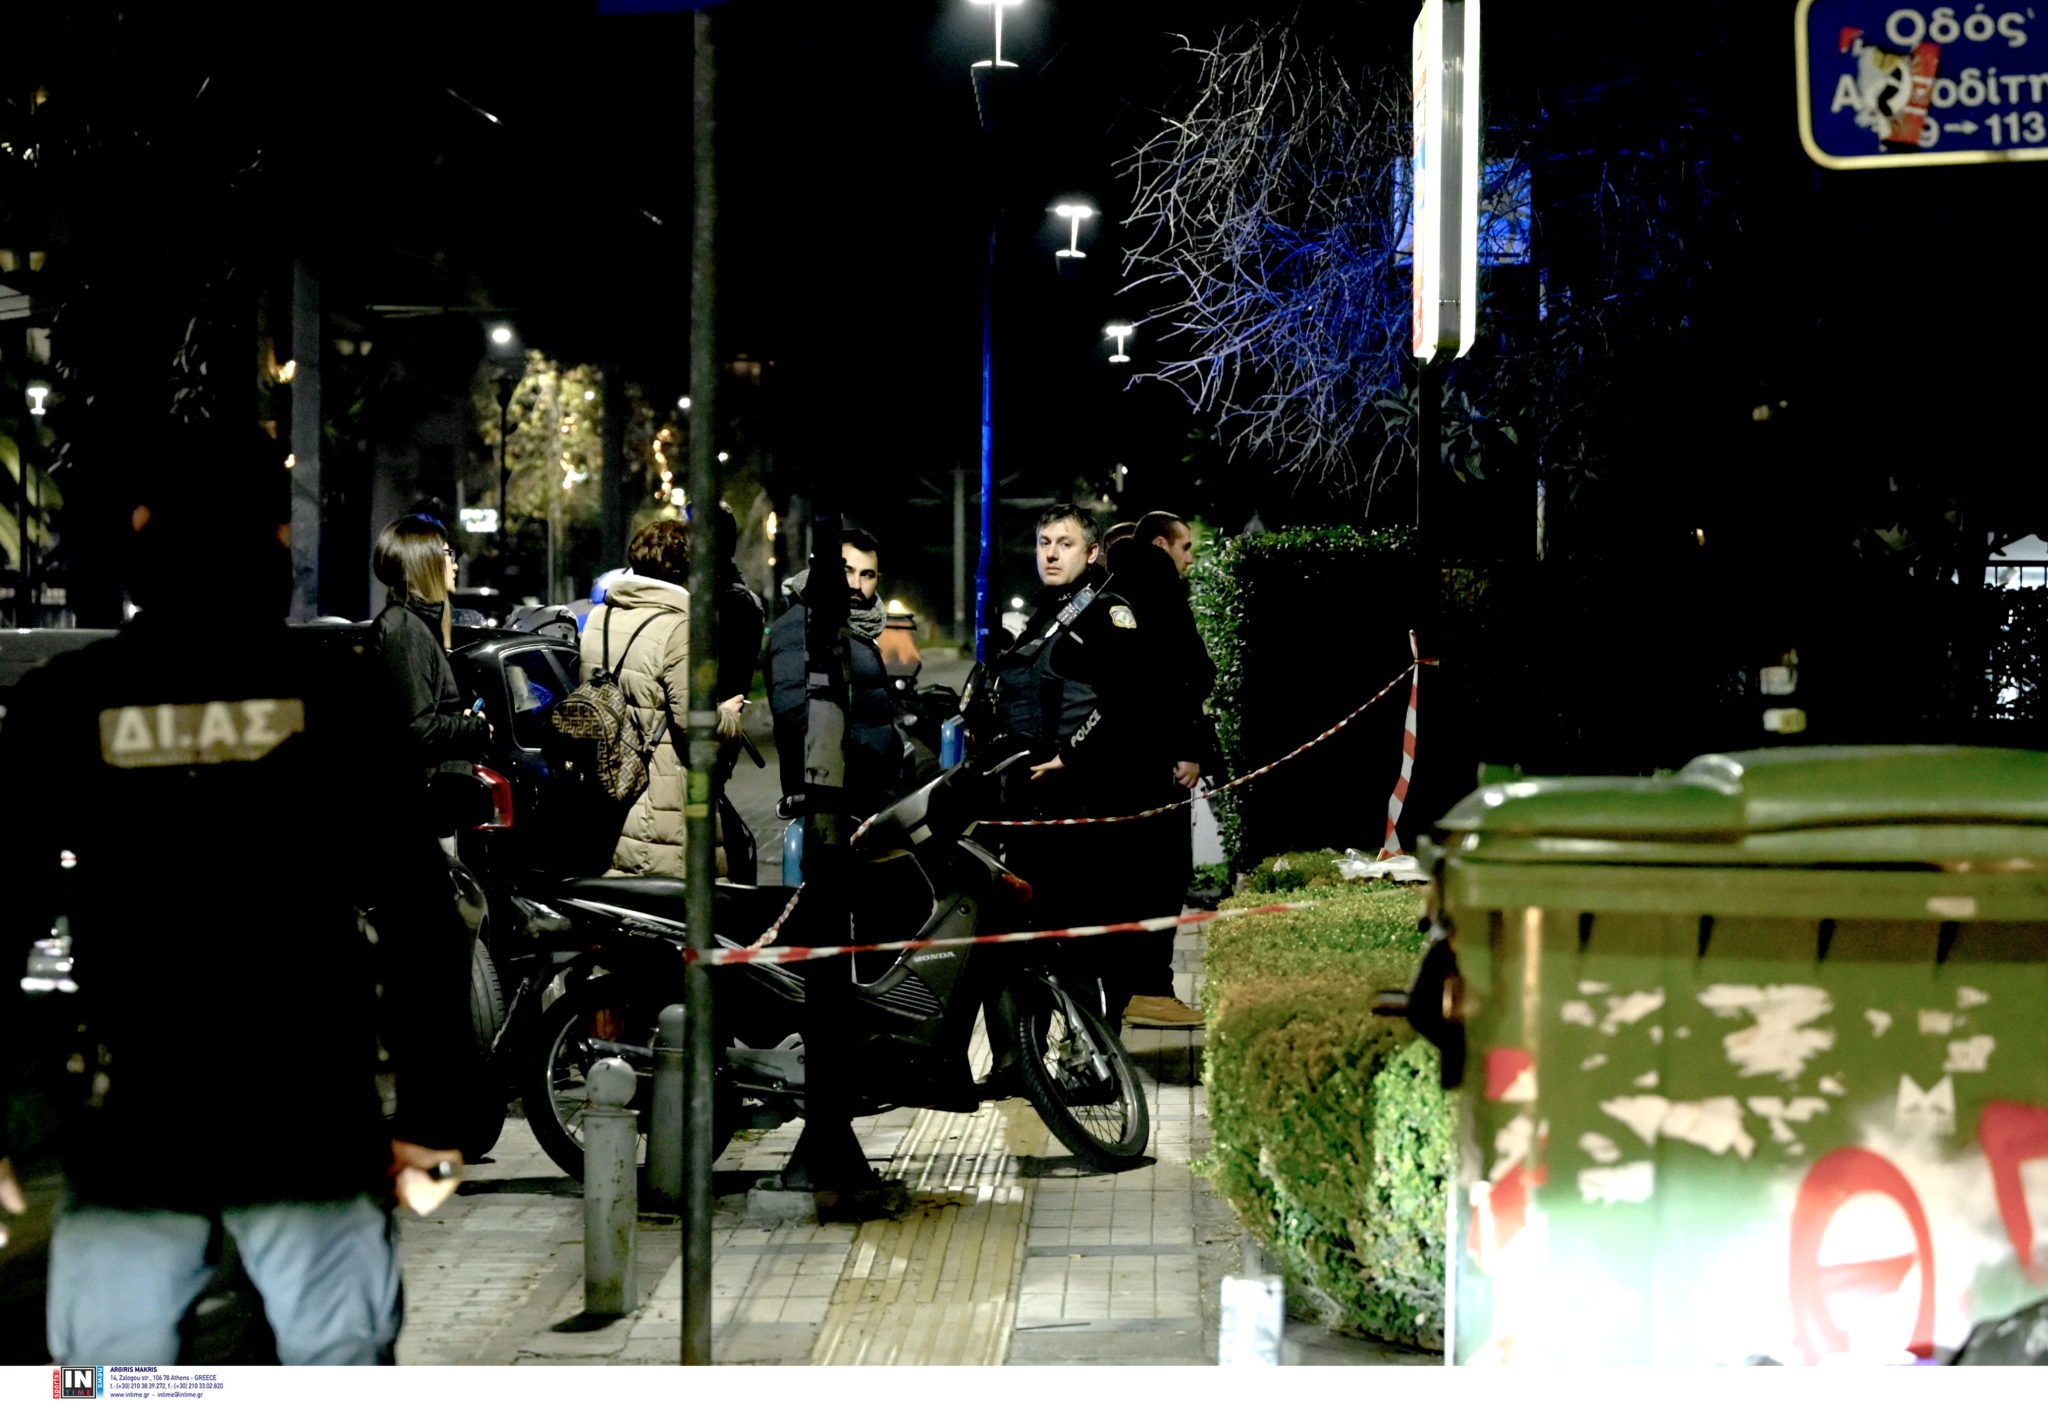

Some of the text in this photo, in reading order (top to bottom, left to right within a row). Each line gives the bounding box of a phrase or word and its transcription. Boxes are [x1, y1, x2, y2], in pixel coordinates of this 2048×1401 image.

[1886, 4, 2028, 48] Οδός
[1831, 67, 2048, 113] Αοδίτη
[1984, 111, 2047, 146] 113
[1069, 708, 1102, 748] POLICE
[913, 951, 956, 963] HONDA
